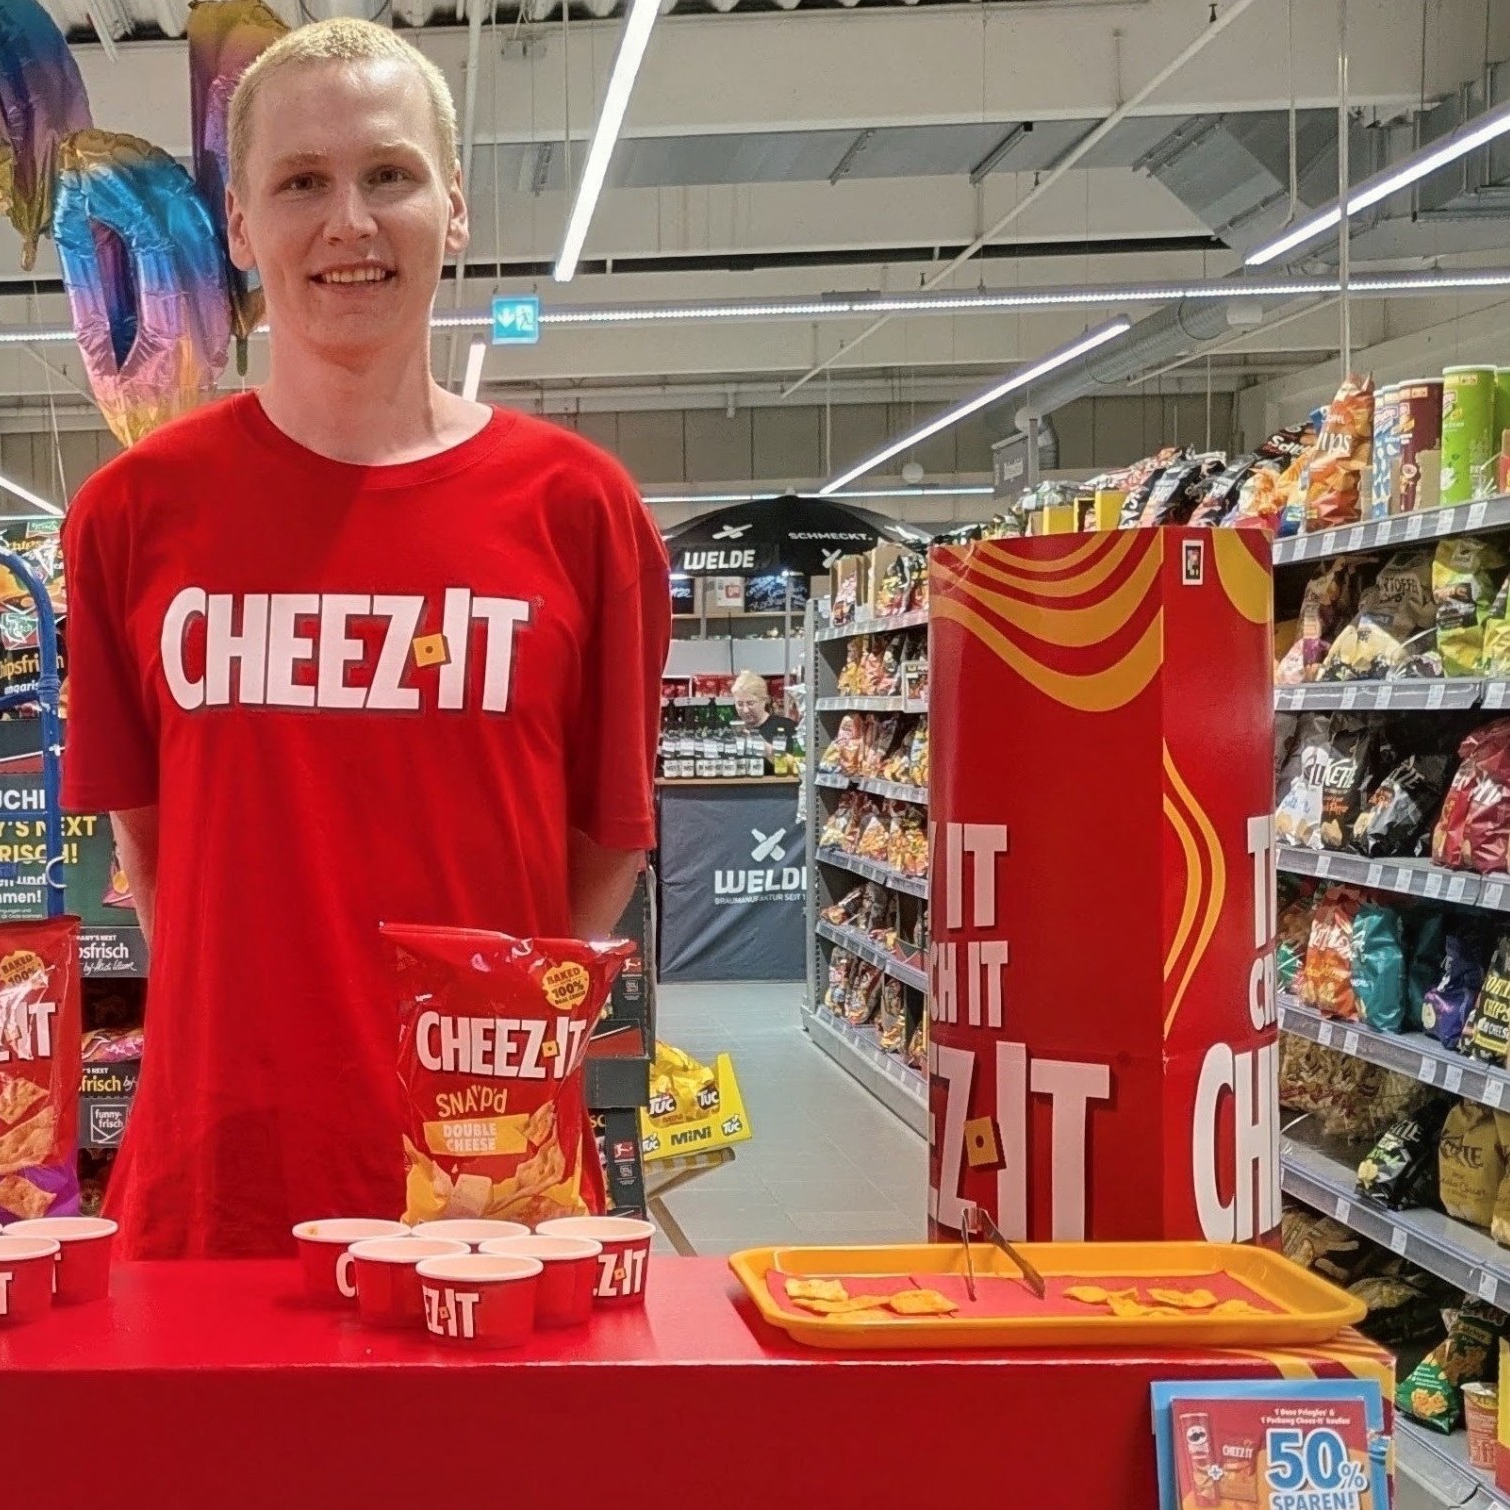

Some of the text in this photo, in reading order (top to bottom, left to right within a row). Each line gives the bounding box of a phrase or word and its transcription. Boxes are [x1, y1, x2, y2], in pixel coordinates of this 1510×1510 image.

[788, 531, 873, 541] SCHMECKT.
[683, 549, 756, 571] WELDE
[946, 822, 1008, 930] IT
[1, 954, 34, 974] BAKED
[546, 967, 581, 985] BAKED
[968, 940, 1009, 1028] IT
[552, 980, 584, 998] 100%
[81, 1075, 121, 1092] frisch
[443, 1122, 498, 1138] DOUBLE
[446, 1137, 497, 1151] CHEESE
[1267, 1430, 1365, 1490] 50%
